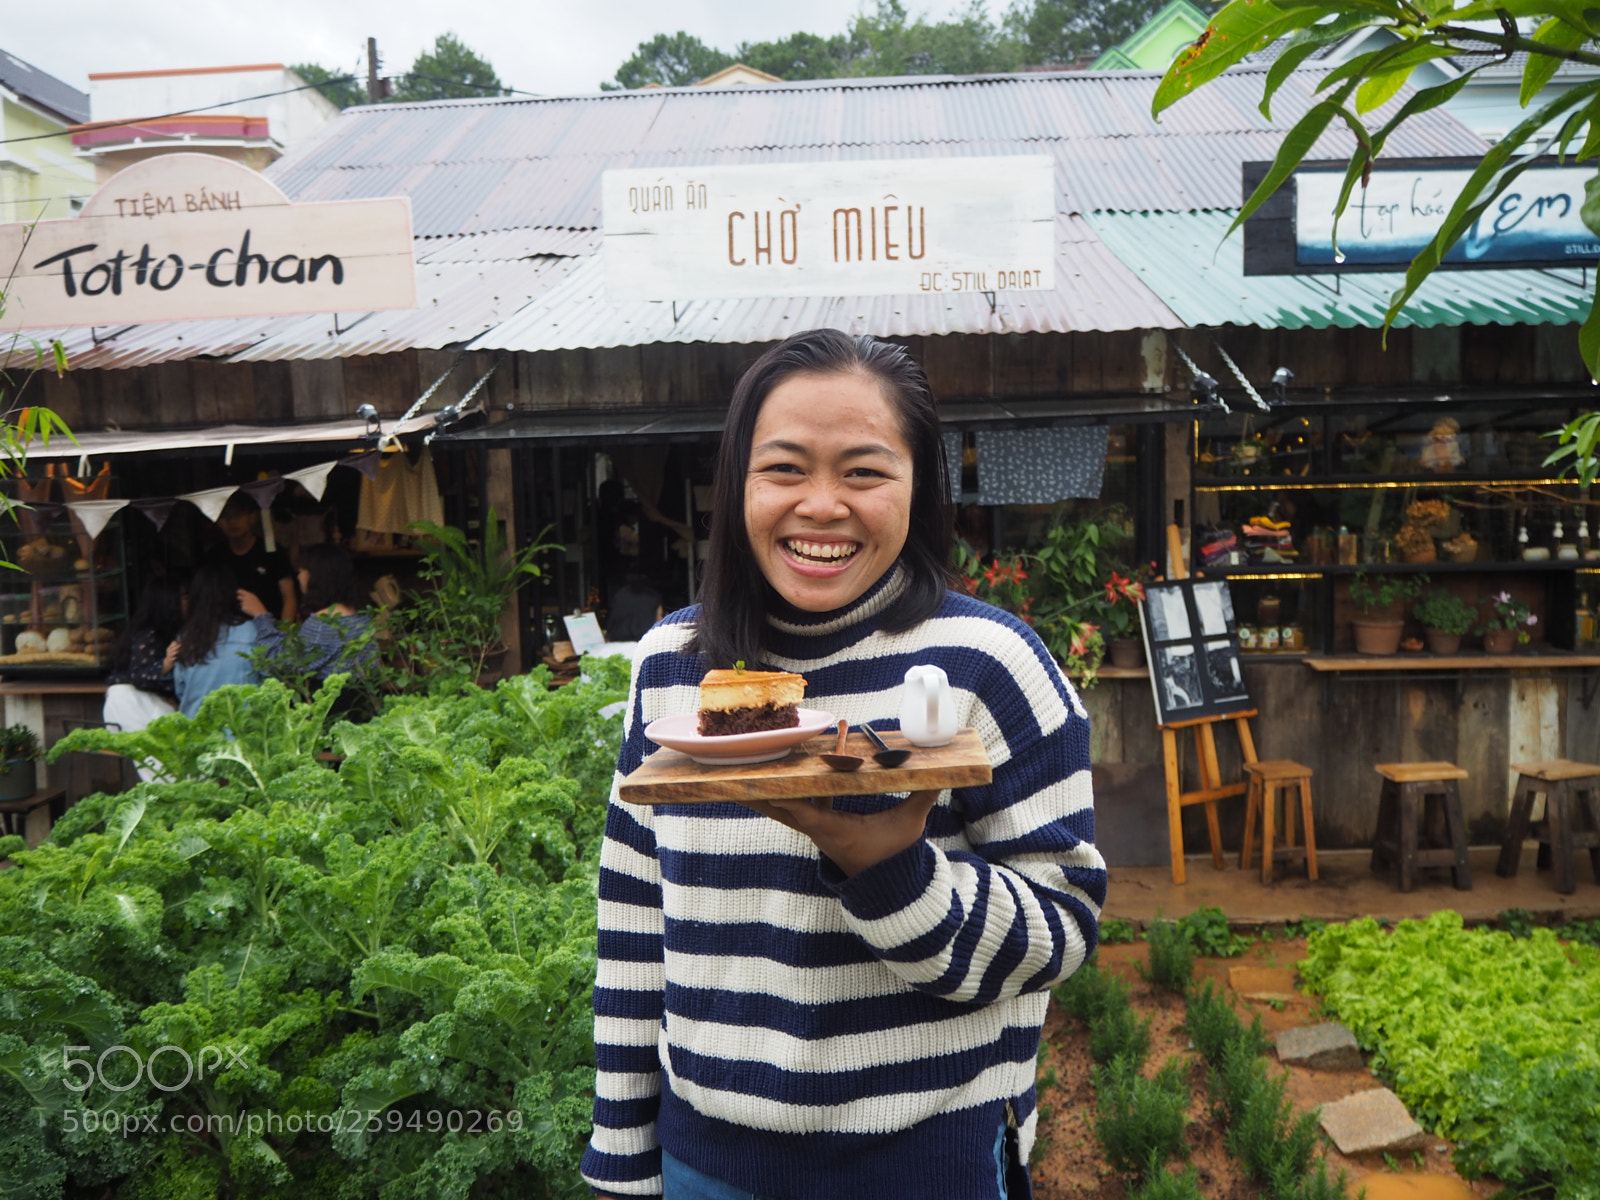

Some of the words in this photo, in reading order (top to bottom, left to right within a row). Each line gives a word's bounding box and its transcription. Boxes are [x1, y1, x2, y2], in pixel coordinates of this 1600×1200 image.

[114, 192, 176, 220] TIỆM
[184, 186, 241, 213] BÁNH
[629, 177, 674, 215] QUÁN
[727, 196, 801, 266] CHỜ
[833, 193, 926, 262] MIÊU
[33, 228, 344, 298] Totto-chan
